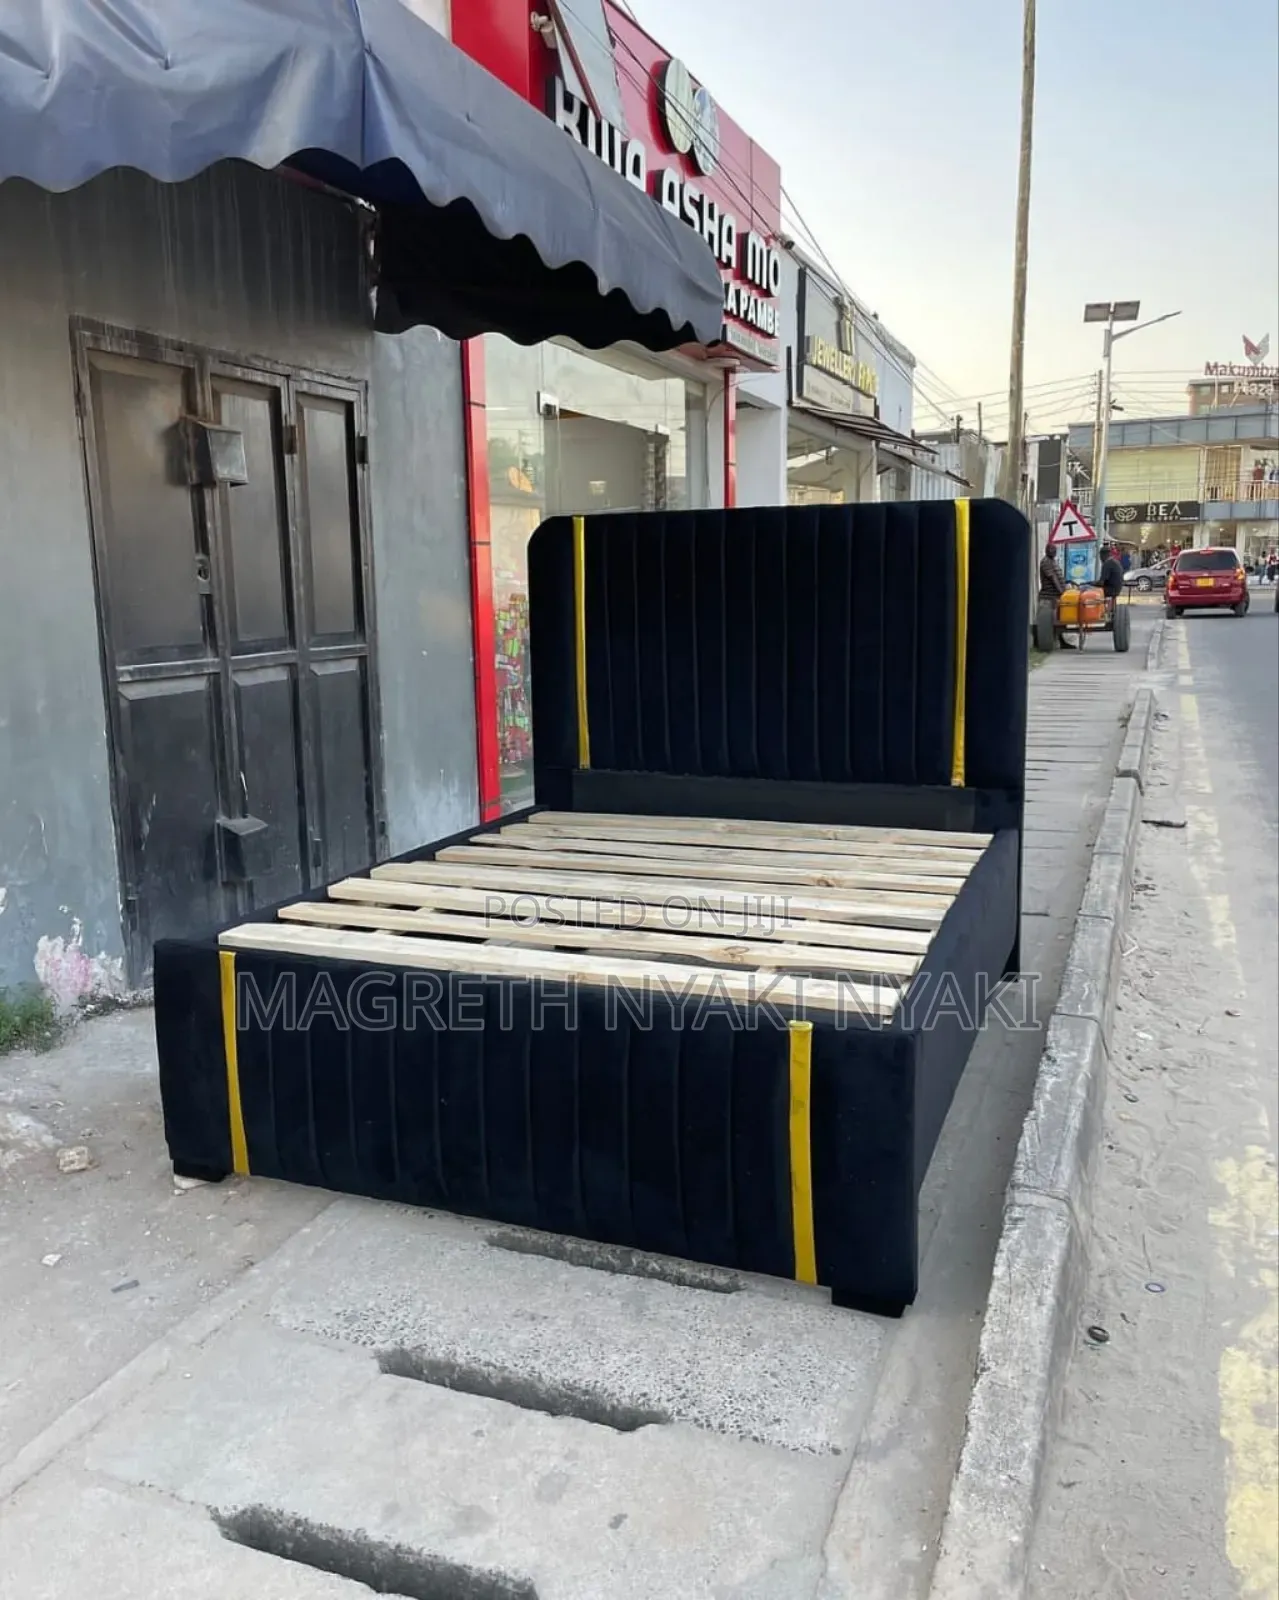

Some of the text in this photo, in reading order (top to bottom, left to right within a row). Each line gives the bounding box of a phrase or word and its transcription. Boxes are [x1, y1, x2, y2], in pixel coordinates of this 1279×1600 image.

[662, 167, 737, 268] ASHA
[1233, 377, 1275, 396] Plaza
[1147, 503, 1181, 516] BEA
